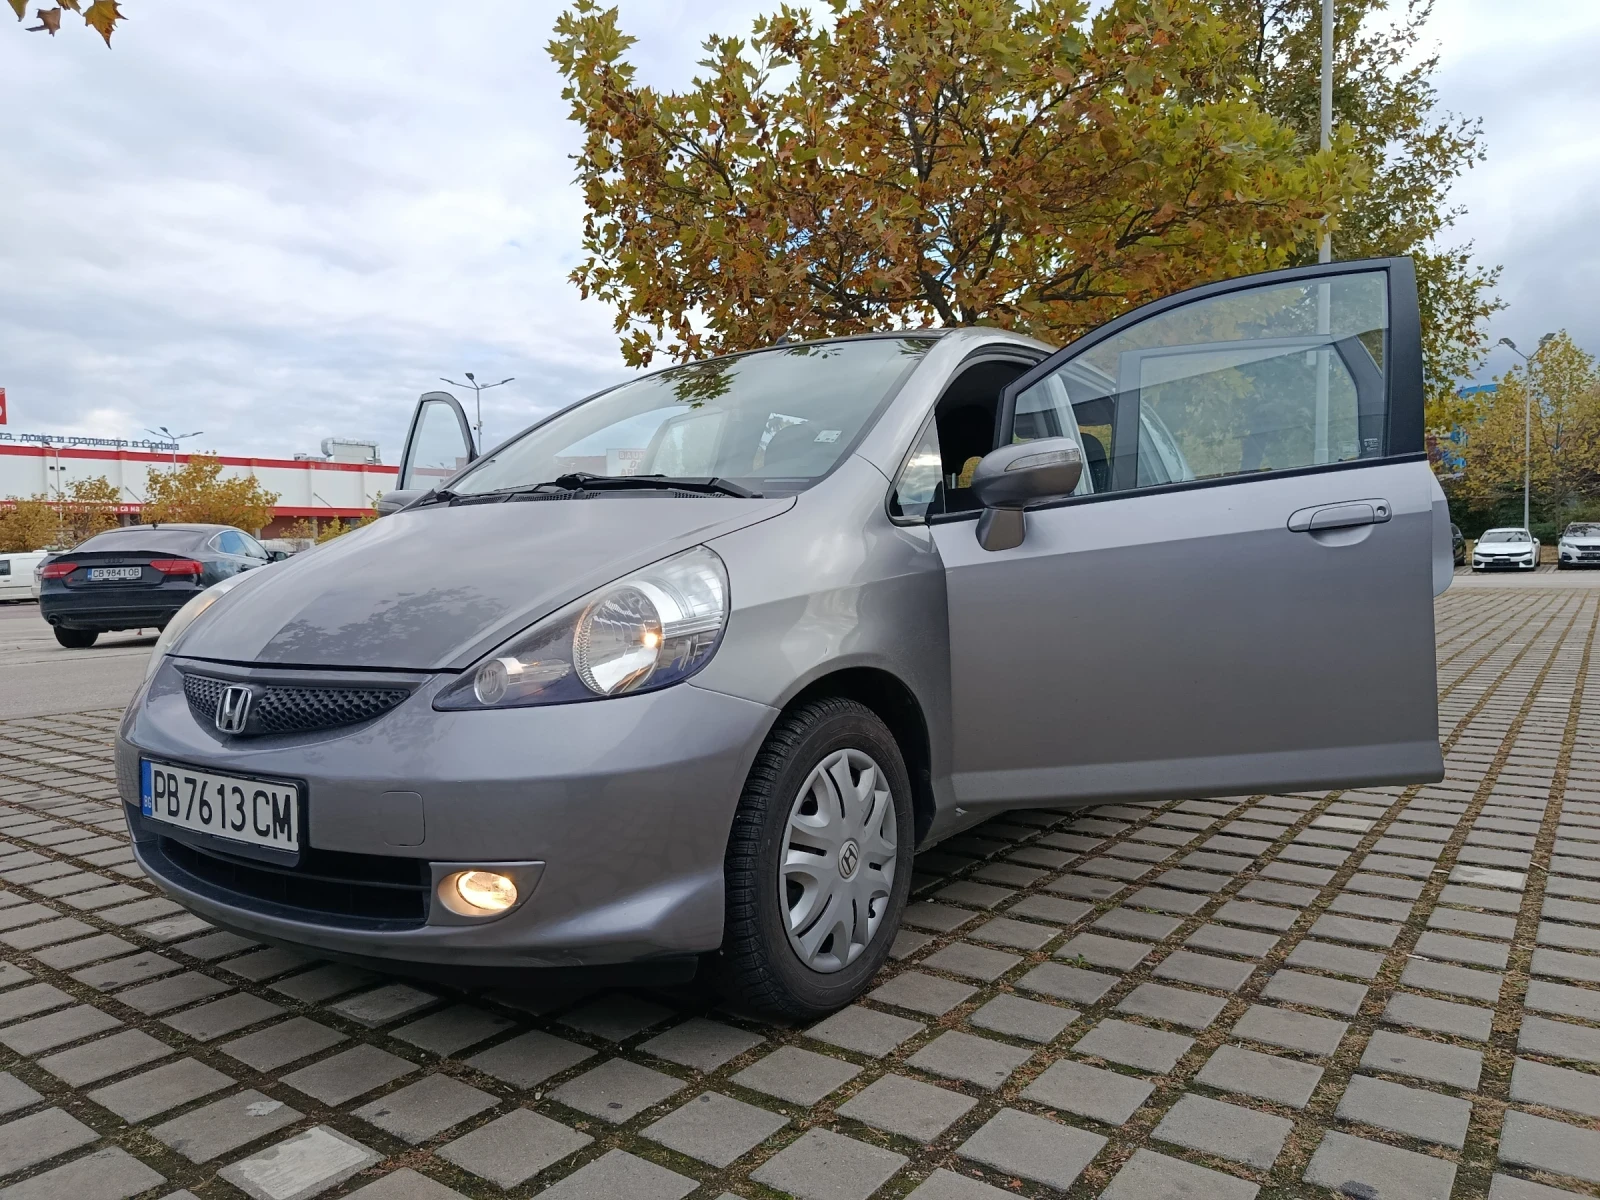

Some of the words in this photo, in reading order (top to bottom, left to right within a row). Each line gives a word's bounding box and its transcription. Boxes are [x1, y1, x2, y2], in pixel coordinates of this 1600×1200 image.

[20, 433, 53, 443] дома
[68, 436, 128, 447] градината
[141, 438, 179, 451] София
